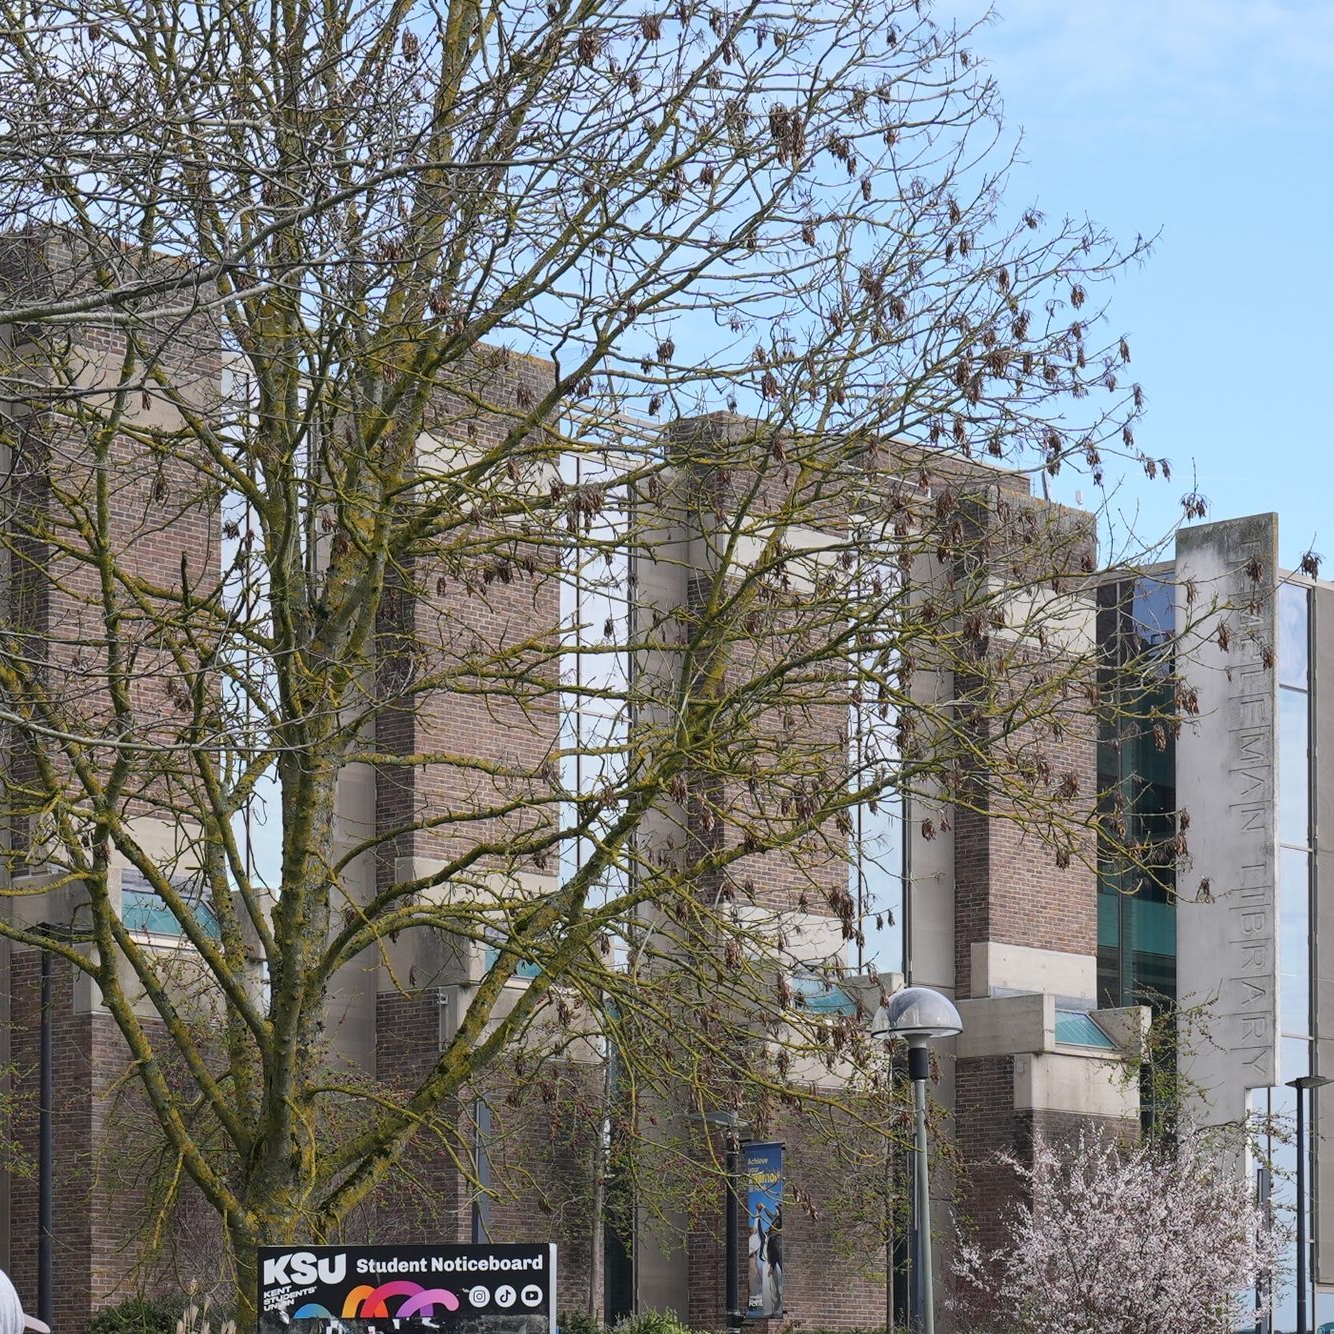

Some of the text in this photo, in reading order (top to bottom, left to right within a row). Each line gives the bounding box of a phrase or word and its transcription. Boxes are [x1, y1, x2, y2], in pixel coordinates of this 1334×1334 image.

[1240, 864, 1267, 1073] LIBRARY
[263, 1252, 347, 1286] KSU
[356, 1254, 543, 1274] Student Noticeboard
[263, 1285, 293, 1299] KENT
[263, 1298, 295, 1312] UNN
